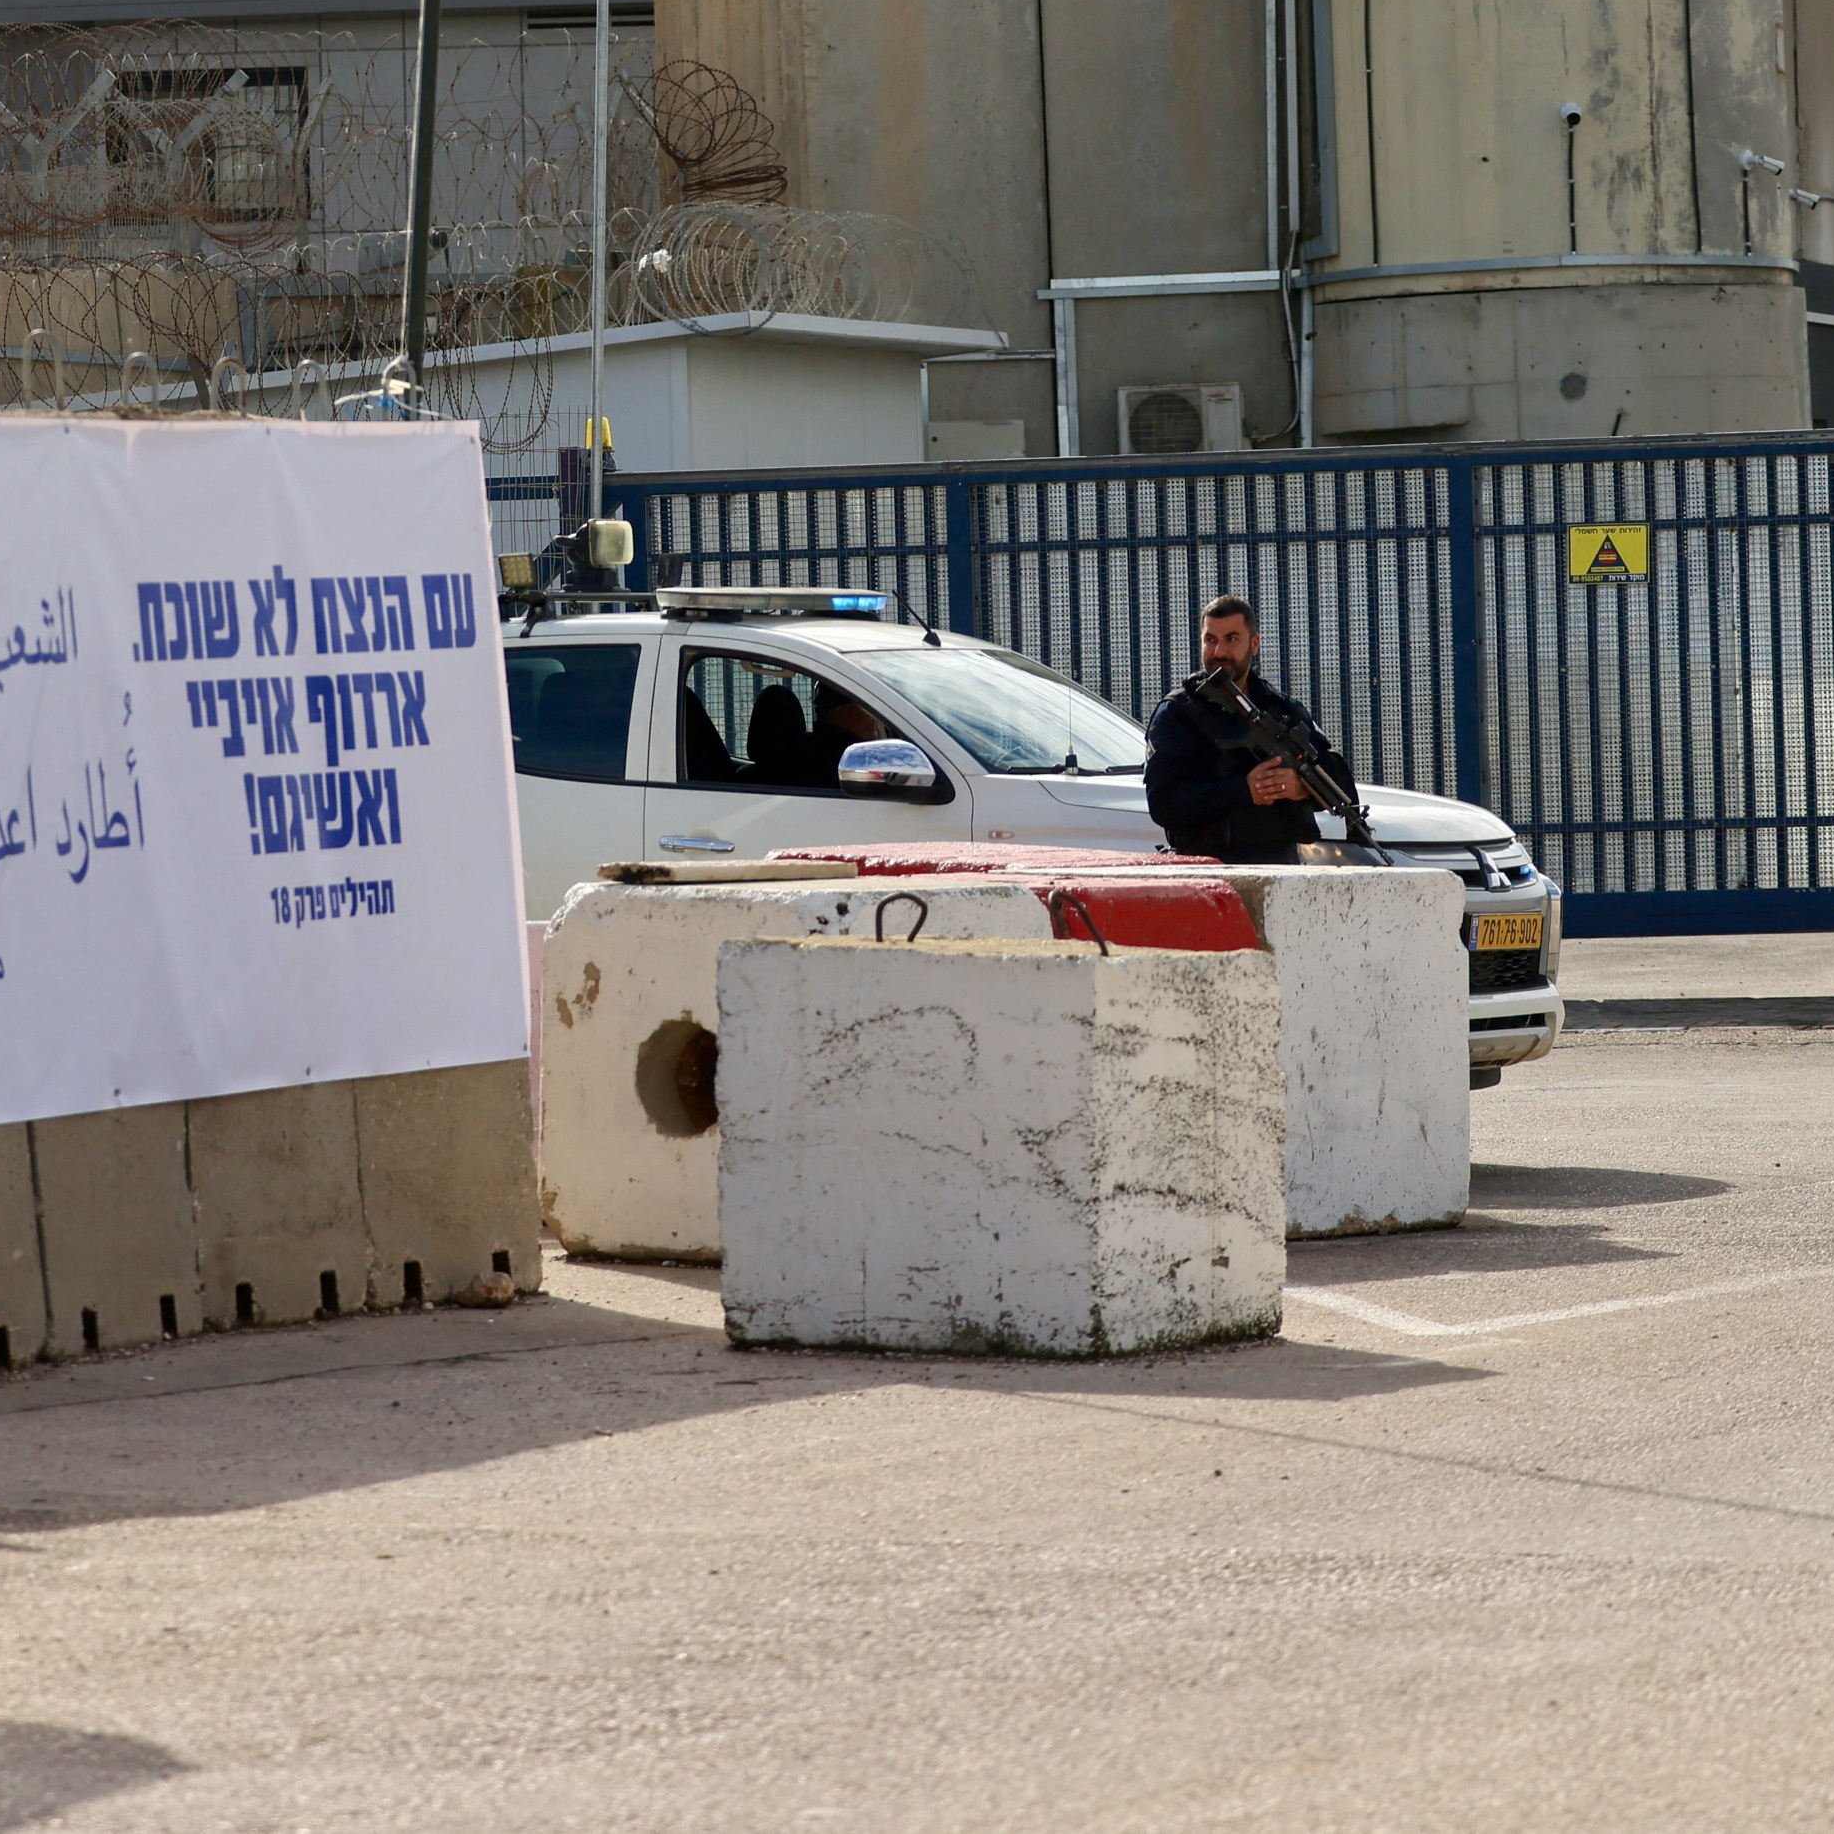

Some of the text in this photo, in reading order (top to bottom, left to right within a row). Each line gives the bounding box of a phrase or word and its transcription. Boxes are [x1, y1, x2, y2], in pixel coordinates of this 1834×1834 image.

[1619, 526, 1642, 534] זהירות
[1608, 574, 1627, 582] שירות
[1629, 574, 1645, 582] מוקד
[133, 565, 476, 662] עם הנצח לא שוכח.
[186, 670, 430, 767] ארדוף אויביי
[244, 768, 402, 855] ואשיגם!
[271, 877, 395, 928] תהילים פרק 18
